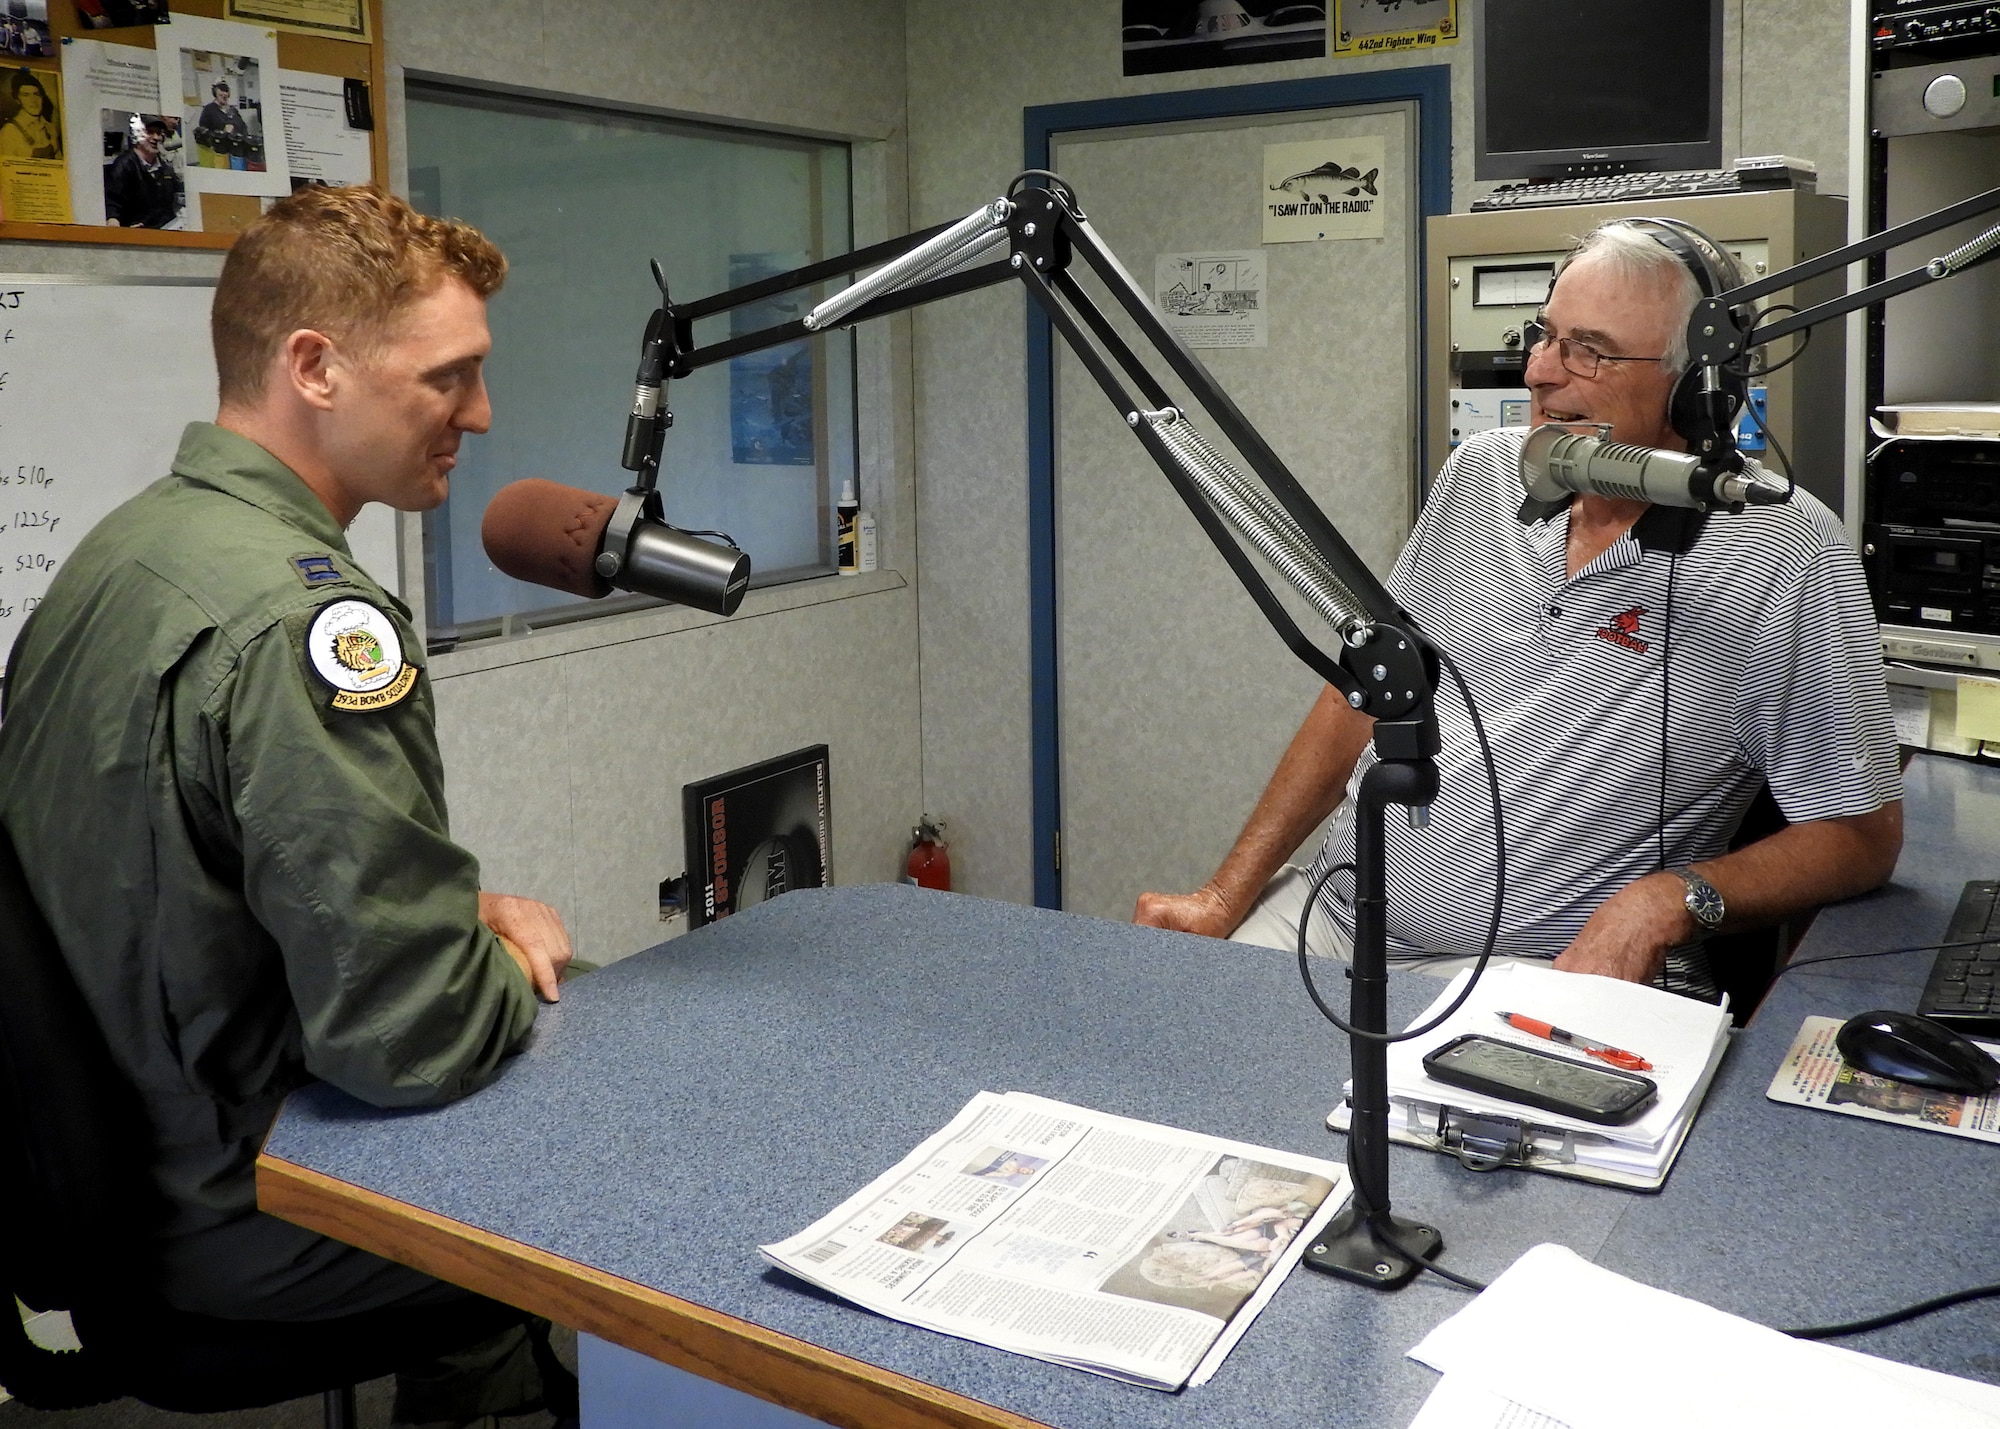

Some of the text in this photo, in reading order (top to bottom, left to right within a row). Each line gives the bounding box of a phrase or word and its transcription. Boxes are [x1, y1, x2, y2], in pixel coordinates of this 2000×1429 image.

[1358, 33, 1437, 51] 442nd Fighter Wing
[1277, 203, 1299, 217] SAW
[1300, 203, 1309, 216] IT
[1309, 202, 1323, 215] ON
[1323, 201, 1341, 214] THE
[1342, 199, 1374, 214] RADIO."
[16, 553, 57, 573] 520p
[335, 666, 415, 706] 393d BOMB SQUADRON
[816, 763, 825, 819] ATHLETICS
[711, 797, 728, 904] SPONSOR
[818, 819, 827, 866] MISSOURI
[705, 882, 716, 917] 2011
